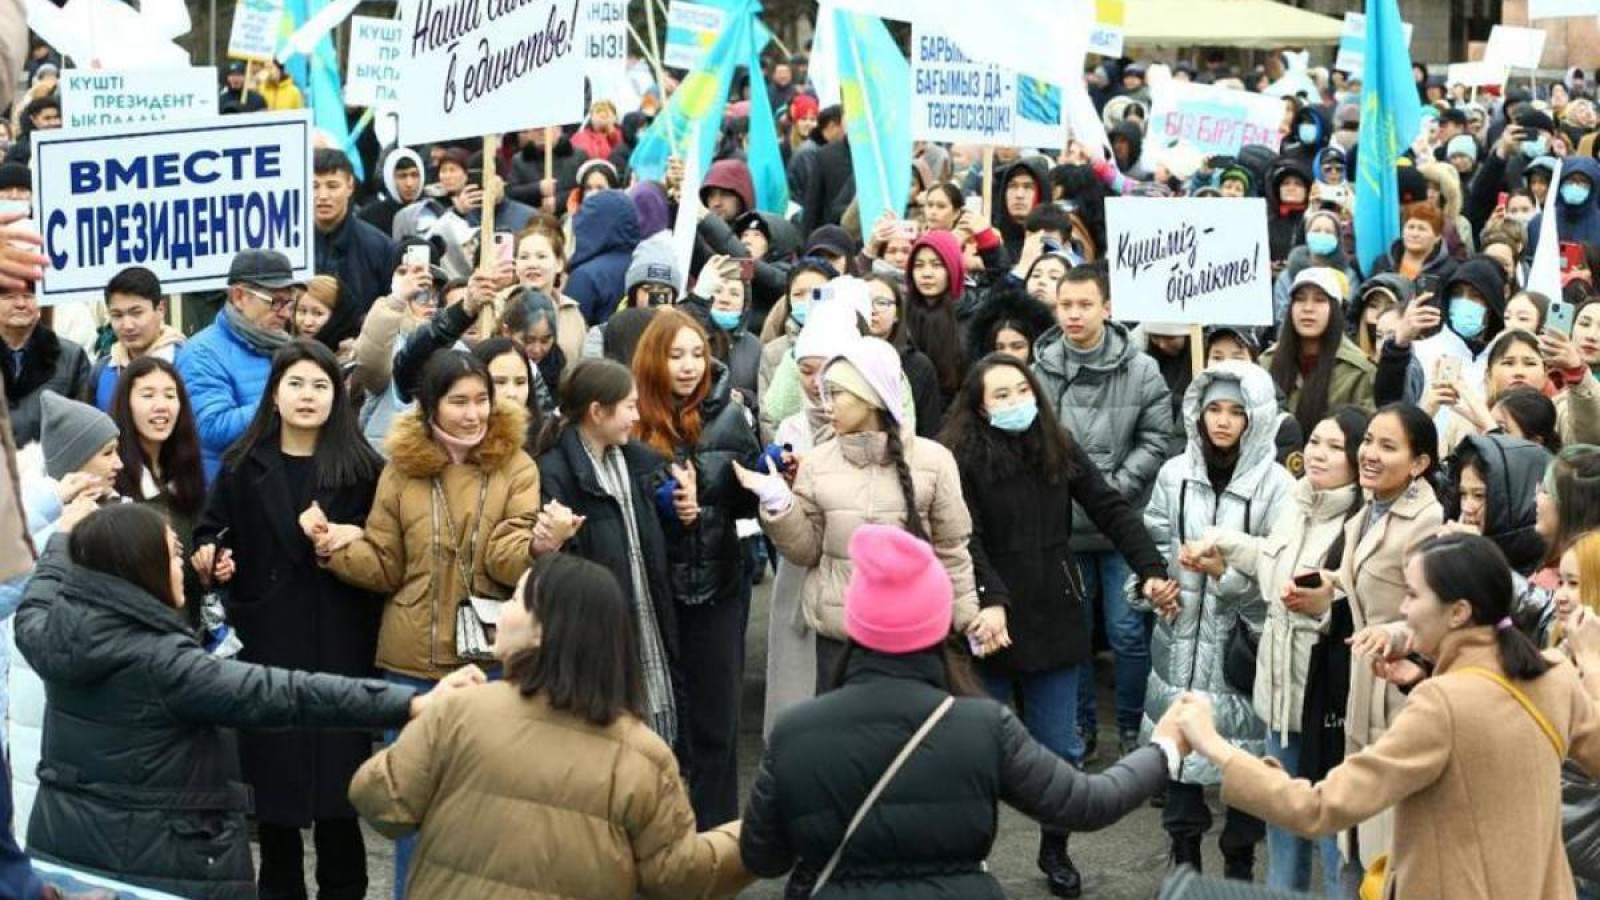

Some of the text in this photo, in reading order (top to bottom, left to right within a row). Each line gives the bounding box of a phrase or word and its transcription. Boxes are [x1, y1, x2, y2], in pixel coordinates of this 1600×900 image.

[93, 93, 195, 109] ПРЕЗИДЕНТ
[70, 145, 281, 195] ВМЕСТЕ
[47, 188, 301, 271] С ПРЕЗИДЕНТОМ!
